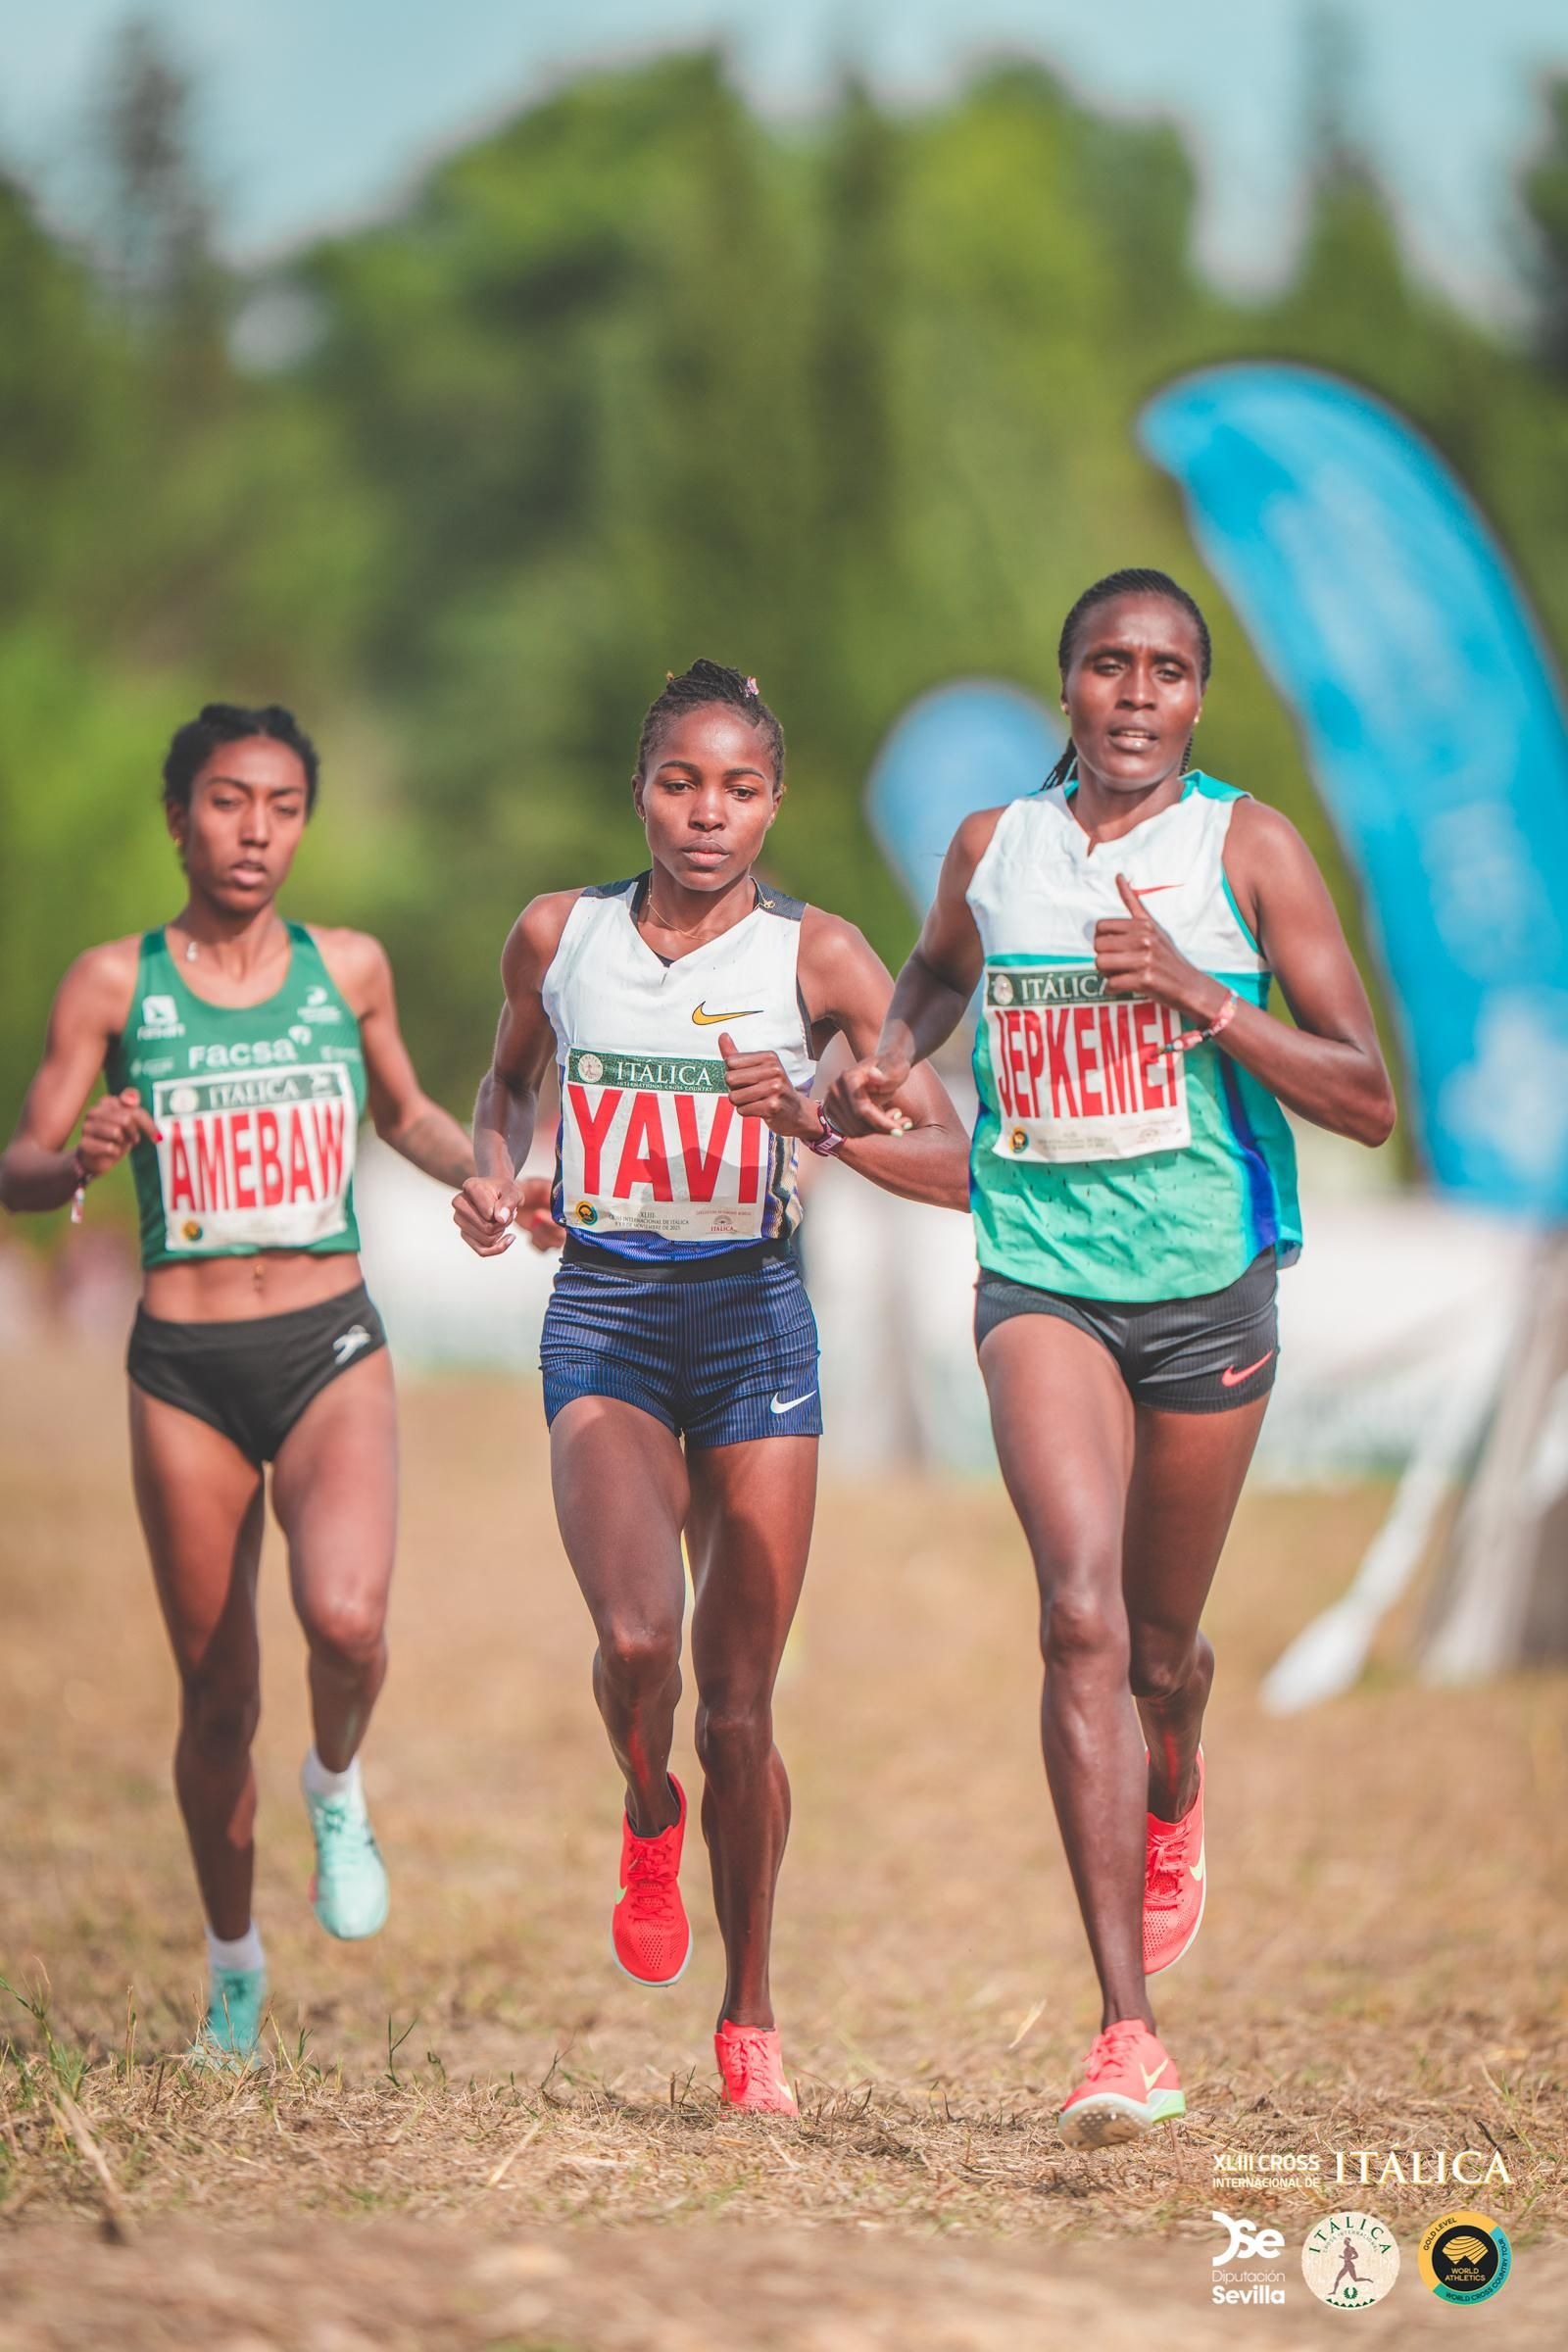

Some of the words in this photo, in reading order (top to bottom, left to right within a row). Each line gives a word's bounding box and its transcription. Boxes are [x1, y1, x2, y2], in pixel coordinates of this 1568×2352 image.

[188, 1038, 297, 1069] Facsa
[616, 1081, 662, 1090] INTERNATIONAL
[617, 1058, 712, 1086] ITÁLICA
[995, 1002, 1178, 1119] JEPKEMEI
[171, 1101, 345, 1212] AMEBAW
[567, 1084, 761, 1204] YAVI
